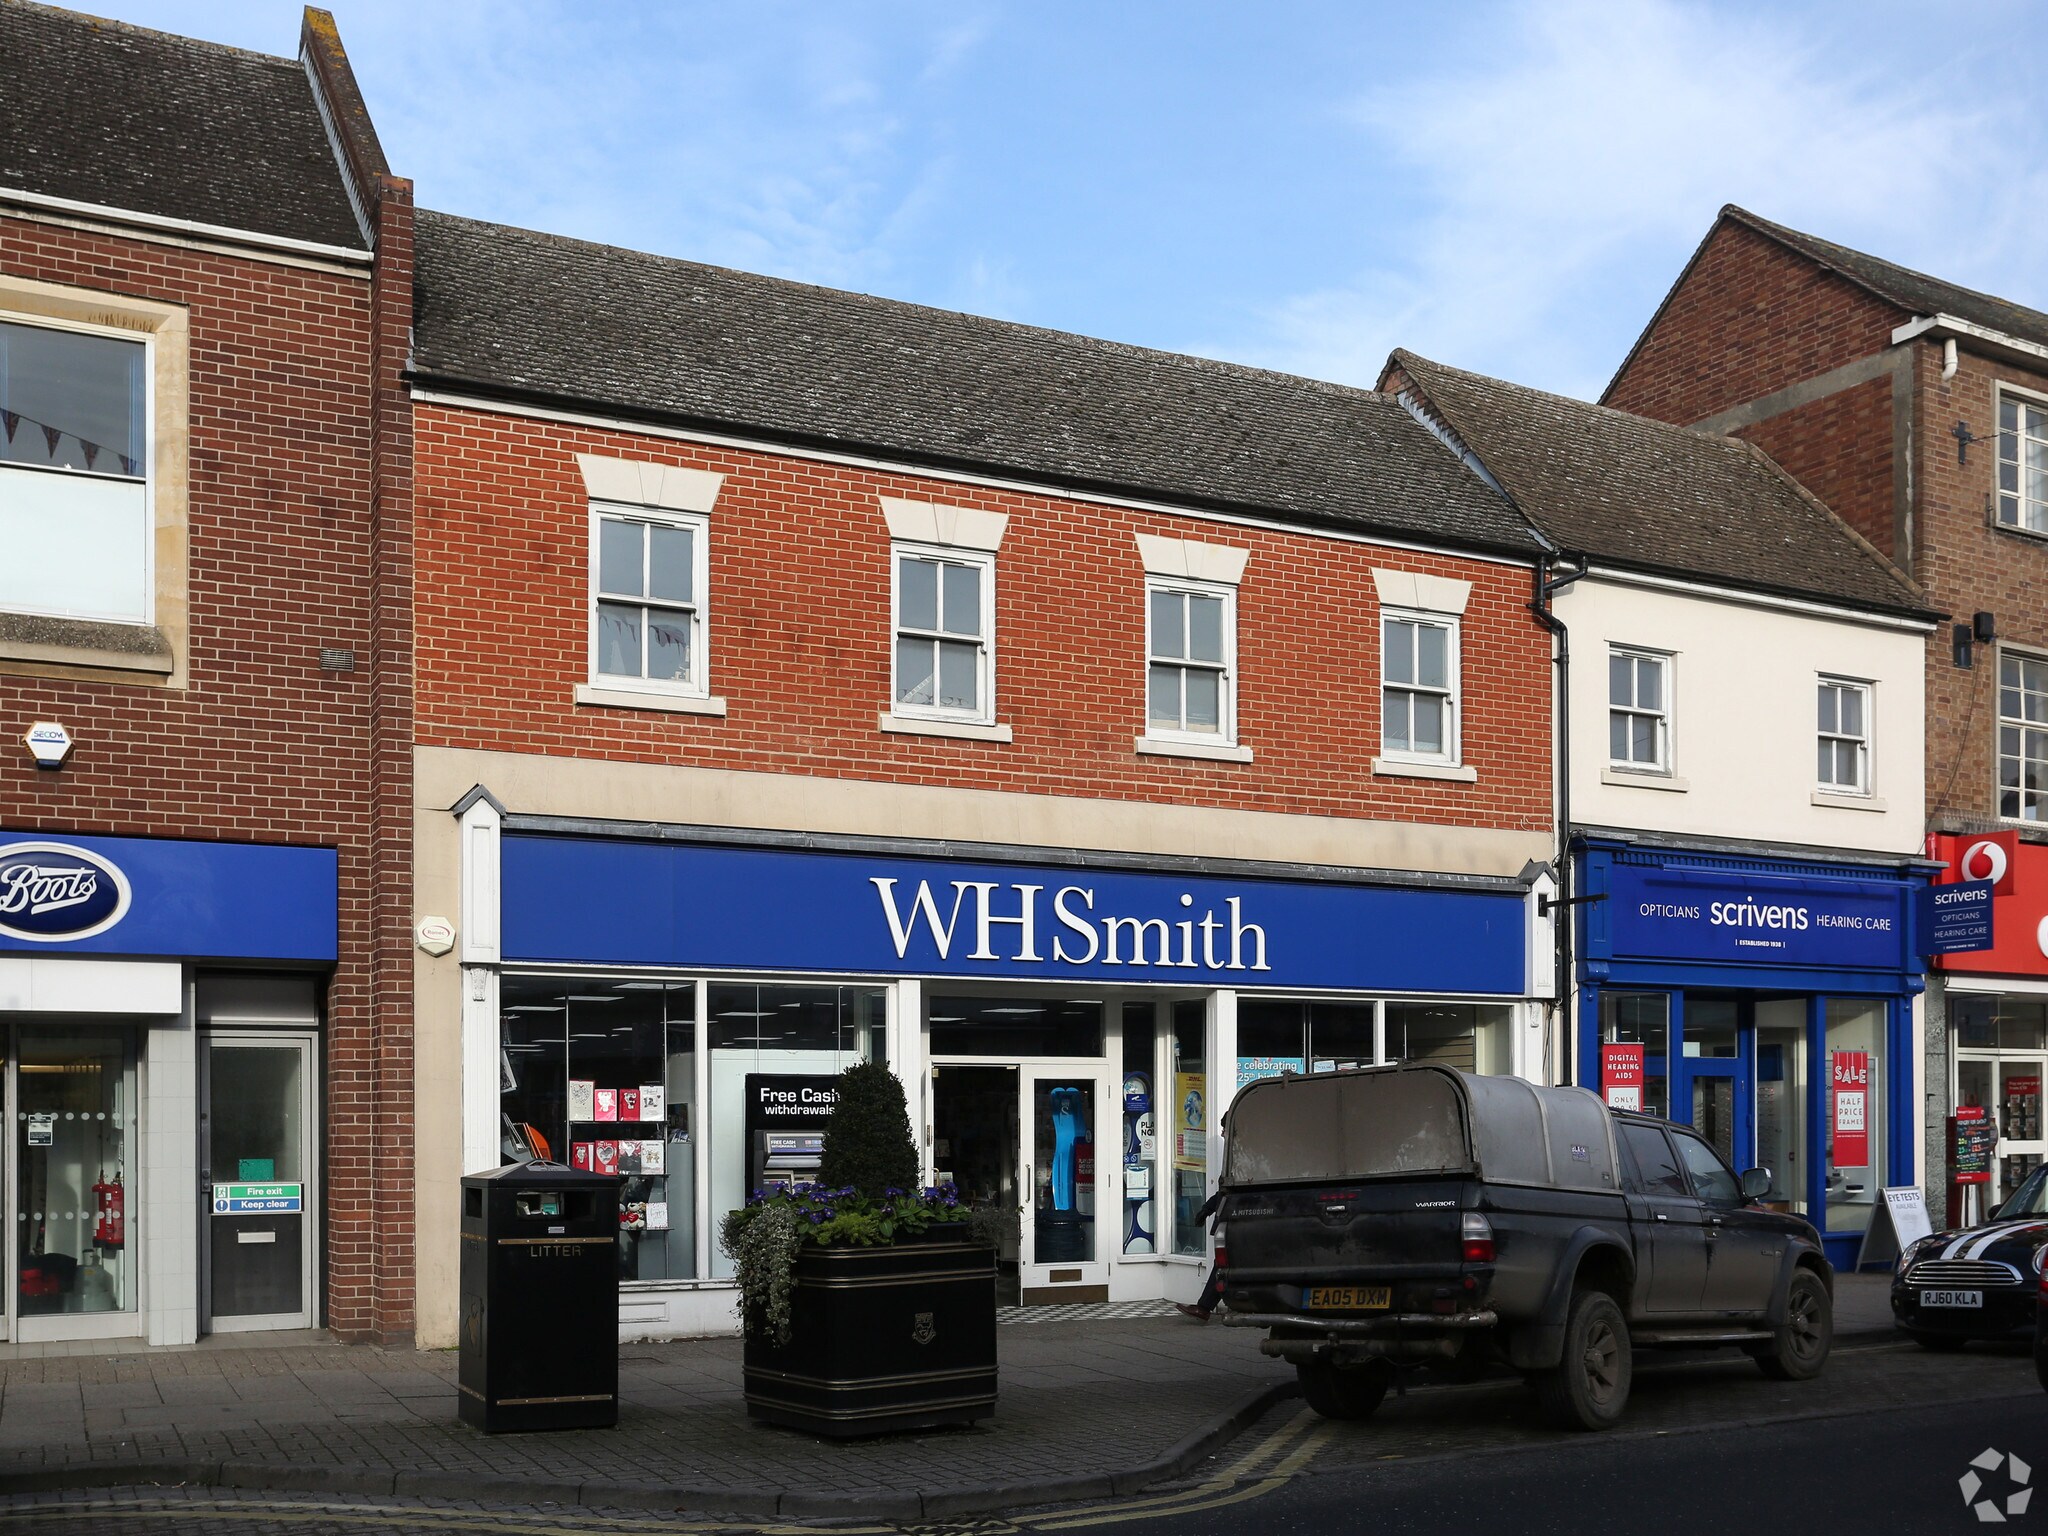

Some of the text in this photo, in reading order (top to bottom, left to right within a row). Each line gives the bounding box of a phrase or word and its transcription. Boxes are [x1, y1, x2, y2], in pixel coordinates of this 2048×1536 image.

[33, 730, 63, 739] SECOM
[0, 864, 97, 915] Boots
[1934, 889, 1988, 905] scrivens
[1639, 896, 1892, 931] OPTICIANS scrivens HEARING CARE
[1941, 911, 1980, 922] OPTICIANS
[868, 876, 1272, 971] WHSmith
[1934, 926, 1988, 938] HEARING CARE
[1739, 939, 1770, 947] ESTABLISHED
[1608, 1054, 1639, 1062] DIGITAL
[1244, 1060, 1297, 1072] celebrating
[1607, 1063, 1640, 1071] HEARING
[1834, 1065, 1867, 1084] SALE
[760, 1087, 797, 1102] Free
[1840, 1097, 1861, 1105] HALF
[764, 1104, 836, 1115] withdrawals
[1838, 1108, 1863, 1116] PRICE
[247, 1187, 283, 1196] Fire exit
[1887, 1192, 1920, 1202] EYE TESTS
[241, 1200, 289, 1210] Keep clear
[1238, 1208, 1274, 1216] MITSUBISHI
[530, 1245, 582, 1257] LITTER
[1311, 1288, 1388, 1306] EA05 DXM
[1924, 1291, 1978, 1305] RJ60 KLA
